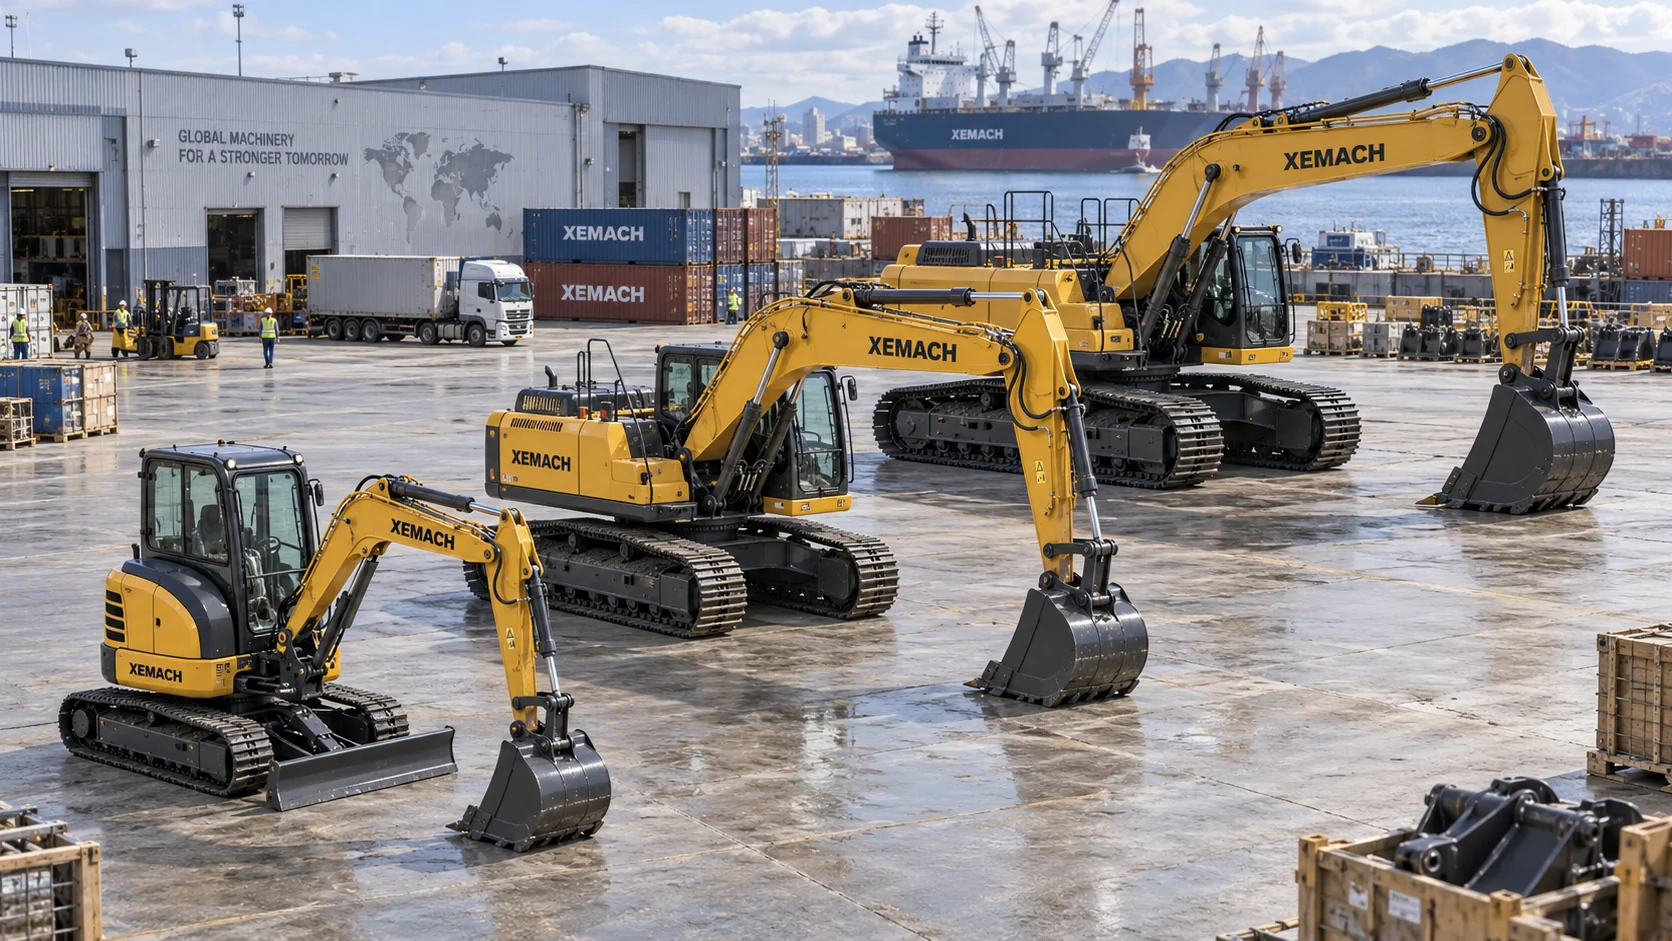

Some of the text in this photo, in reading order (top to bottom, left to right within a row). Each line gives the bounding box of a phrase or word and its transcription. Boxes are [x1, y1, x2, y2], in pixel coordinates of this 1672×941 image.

[178, 129, 295, 147] GLOBAL MACHINERY
[951, 129, 1004, 141] XEMACH
[178, 148, 349, 166] FOR A STRONGER TOMORROW
[1283, 142, 1386, 172] XEMACH
[562, 225, 645, 243] XEMACH
[560, 283, 646, 303] XEMACH
[867, 335, 958, 363] XEMACH
[511, 449, 572, 472] XEMACH
[390, 517, 456, 551] XEMACH
[128, 662, 183, 684] XEMACH
